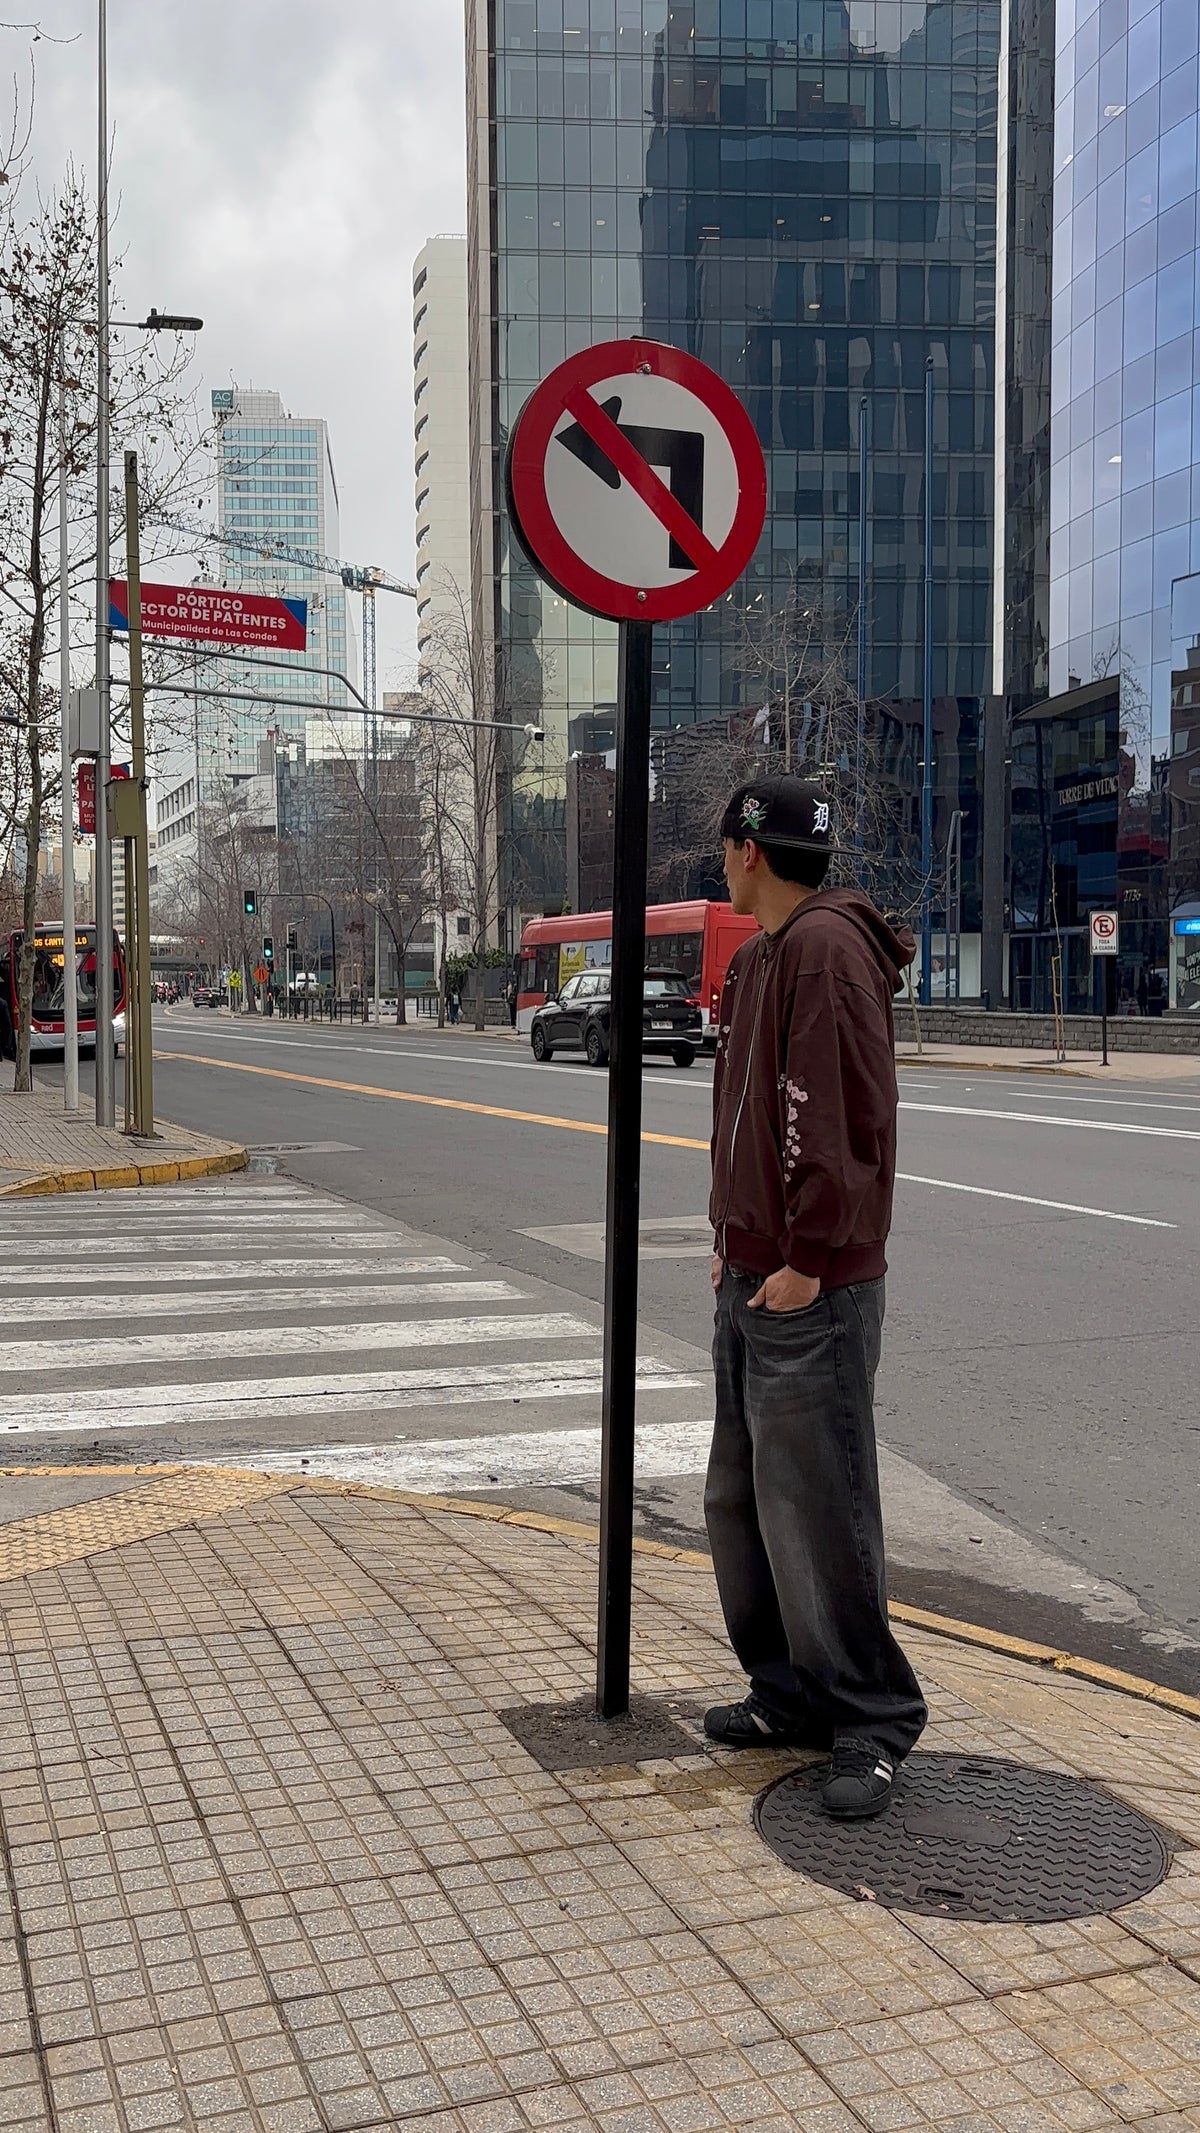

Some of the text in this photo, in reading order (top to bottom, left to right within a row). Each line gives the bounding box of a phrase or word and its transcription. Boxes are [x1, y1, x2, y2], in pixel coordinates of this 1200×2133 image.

[214, 392, 231, 401] AC
[177, 591, 243, 611] PÓRTICO
[140, 602, 287, 629] ECTOR DE PATENTES
[142, 620, 277, 642] Municipalidad de Las Condes
[1058, 785, 1082, 805] TORRE
[1095, 775, 1120, 796] VITAC
